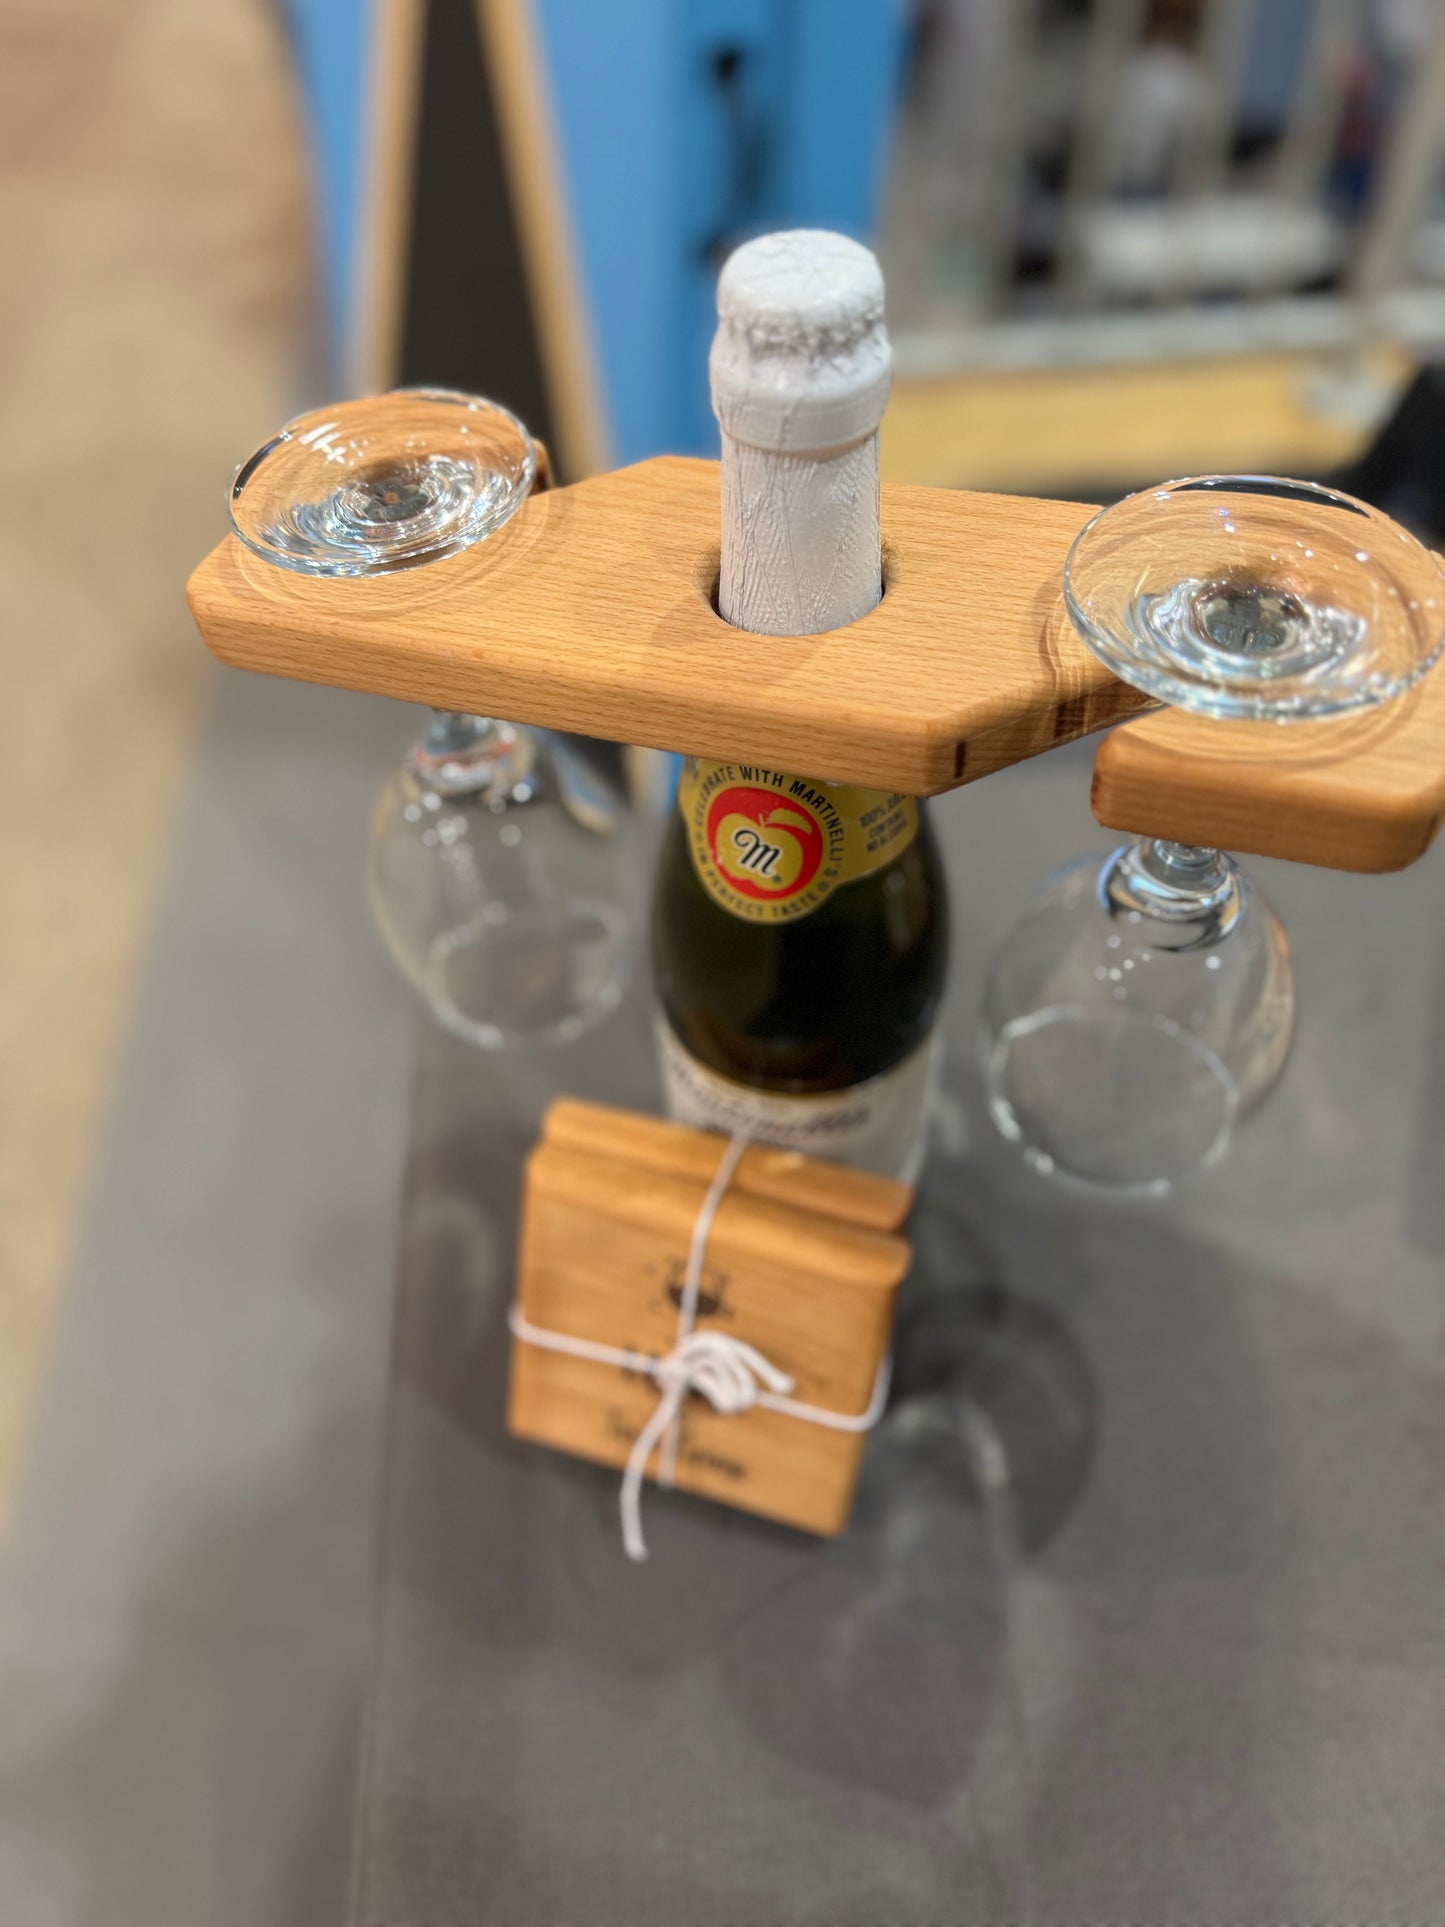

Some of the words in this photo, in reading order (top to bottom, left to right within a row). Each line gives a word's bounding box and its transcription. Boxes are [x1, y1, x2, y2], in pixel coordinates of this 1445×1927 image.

[695, 766, 736, 827] CELEBRATE
[739, 766, 784, 788] WITH
[789, 780, 845, 878] MARTINELLI'S
